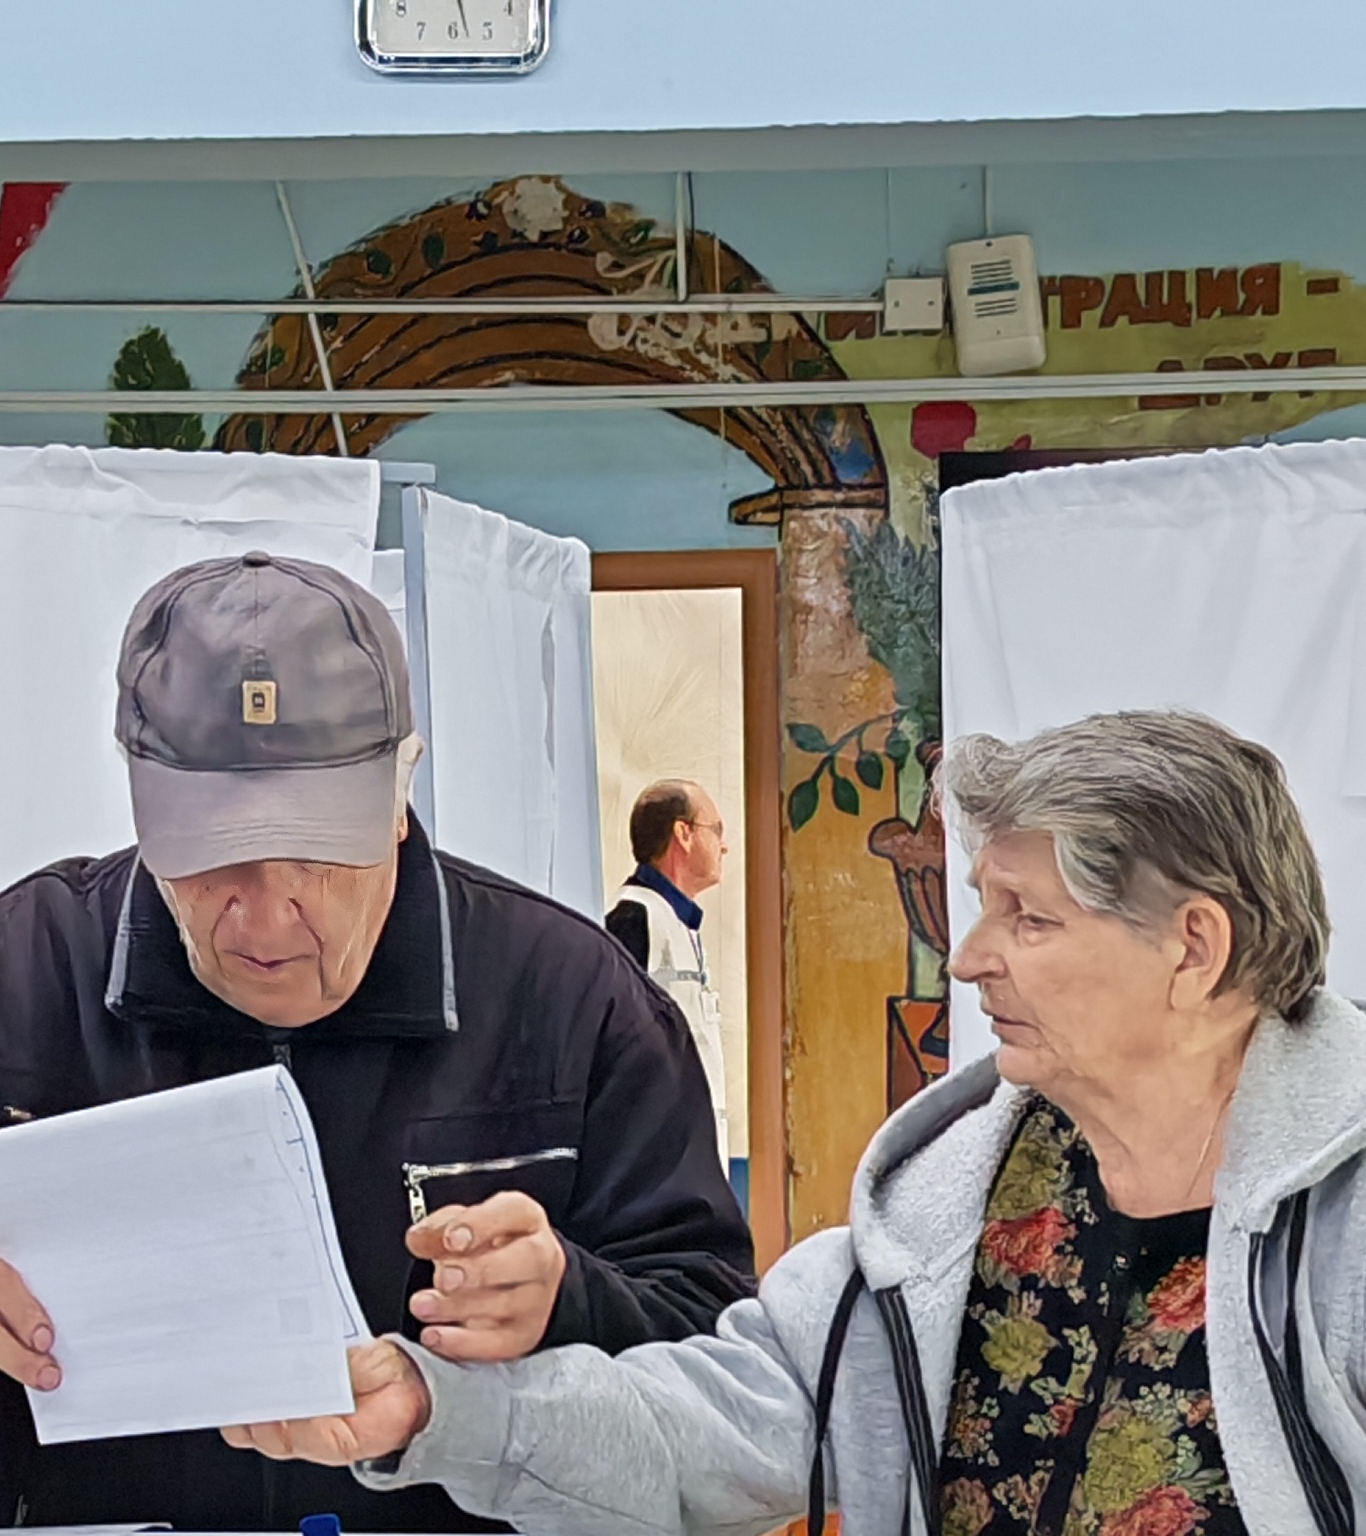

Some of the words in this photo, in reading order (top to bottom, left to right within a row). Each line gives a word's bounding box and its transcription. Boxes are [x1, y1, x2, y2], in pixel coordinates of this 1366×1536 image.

[416, 21, 426, 41] 7
[448, 21, 458, 40] 6
[482, 21, 492, 40] 5
